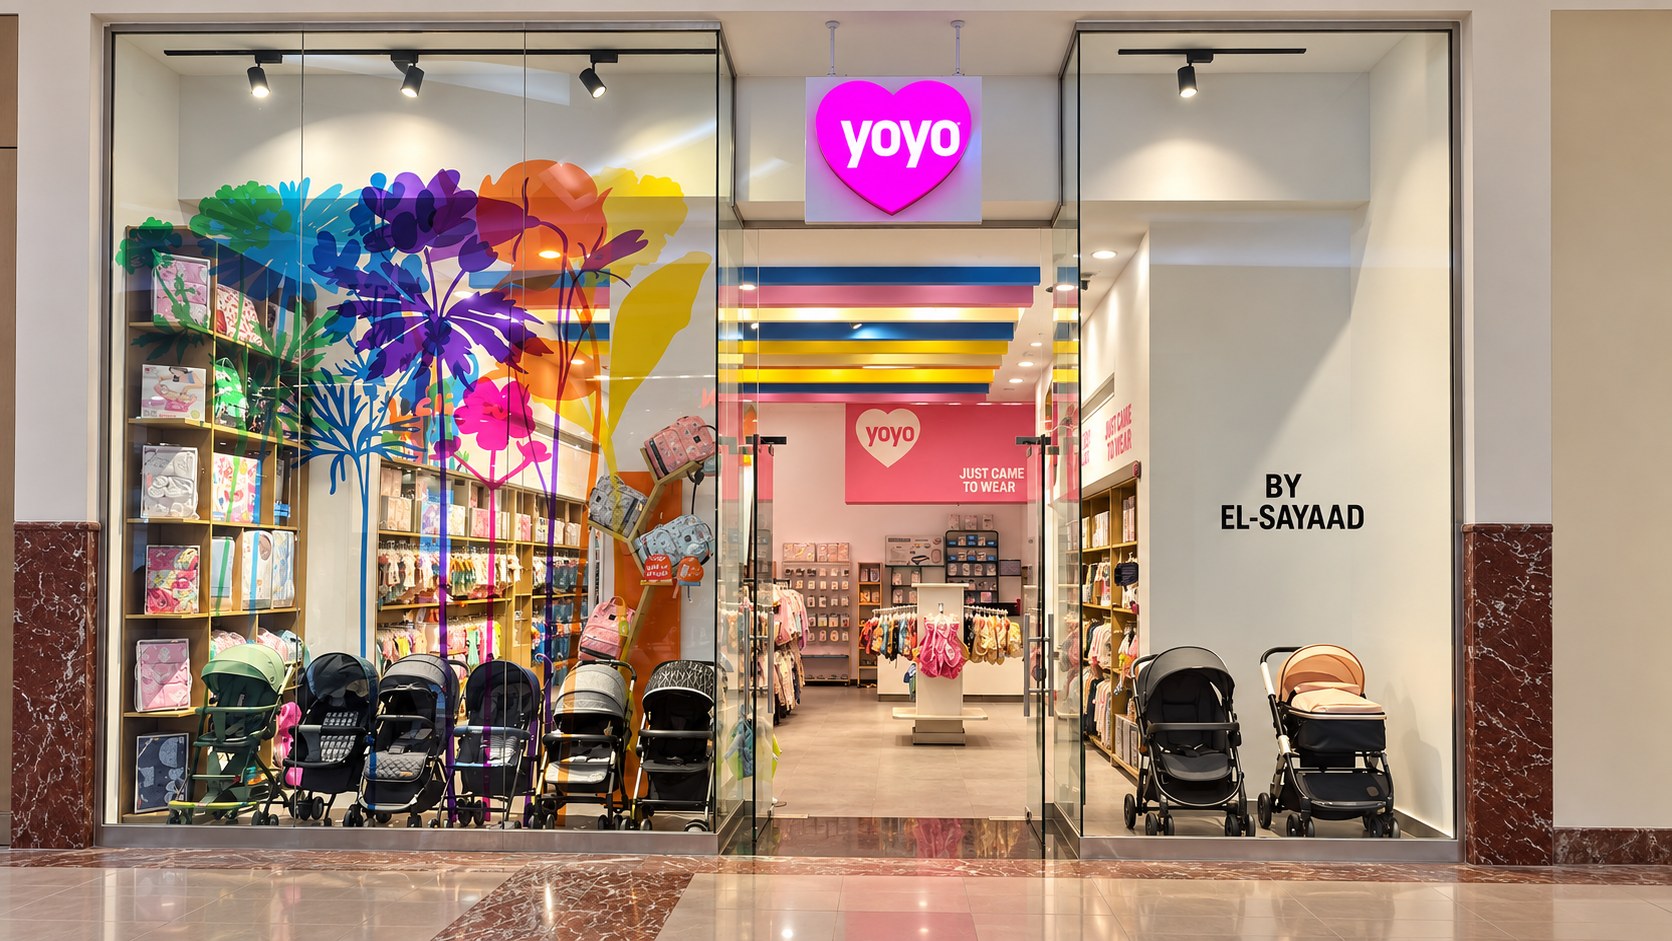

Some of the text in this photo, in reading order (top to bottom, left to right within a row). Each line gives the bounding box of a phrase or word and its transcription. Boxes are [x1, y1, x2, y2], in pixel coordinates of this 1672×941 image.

[840, 119, 961, 169] yoyo
[866, 426, 914, 447] yoyo
[959, 467, 1025, 480] JUST CAME
[962, 481, 1016, 493] TO WEAR
[1265, 473, 1302, 499] BY
[1220, 504, 1365, 530] EL-SAYAAD
